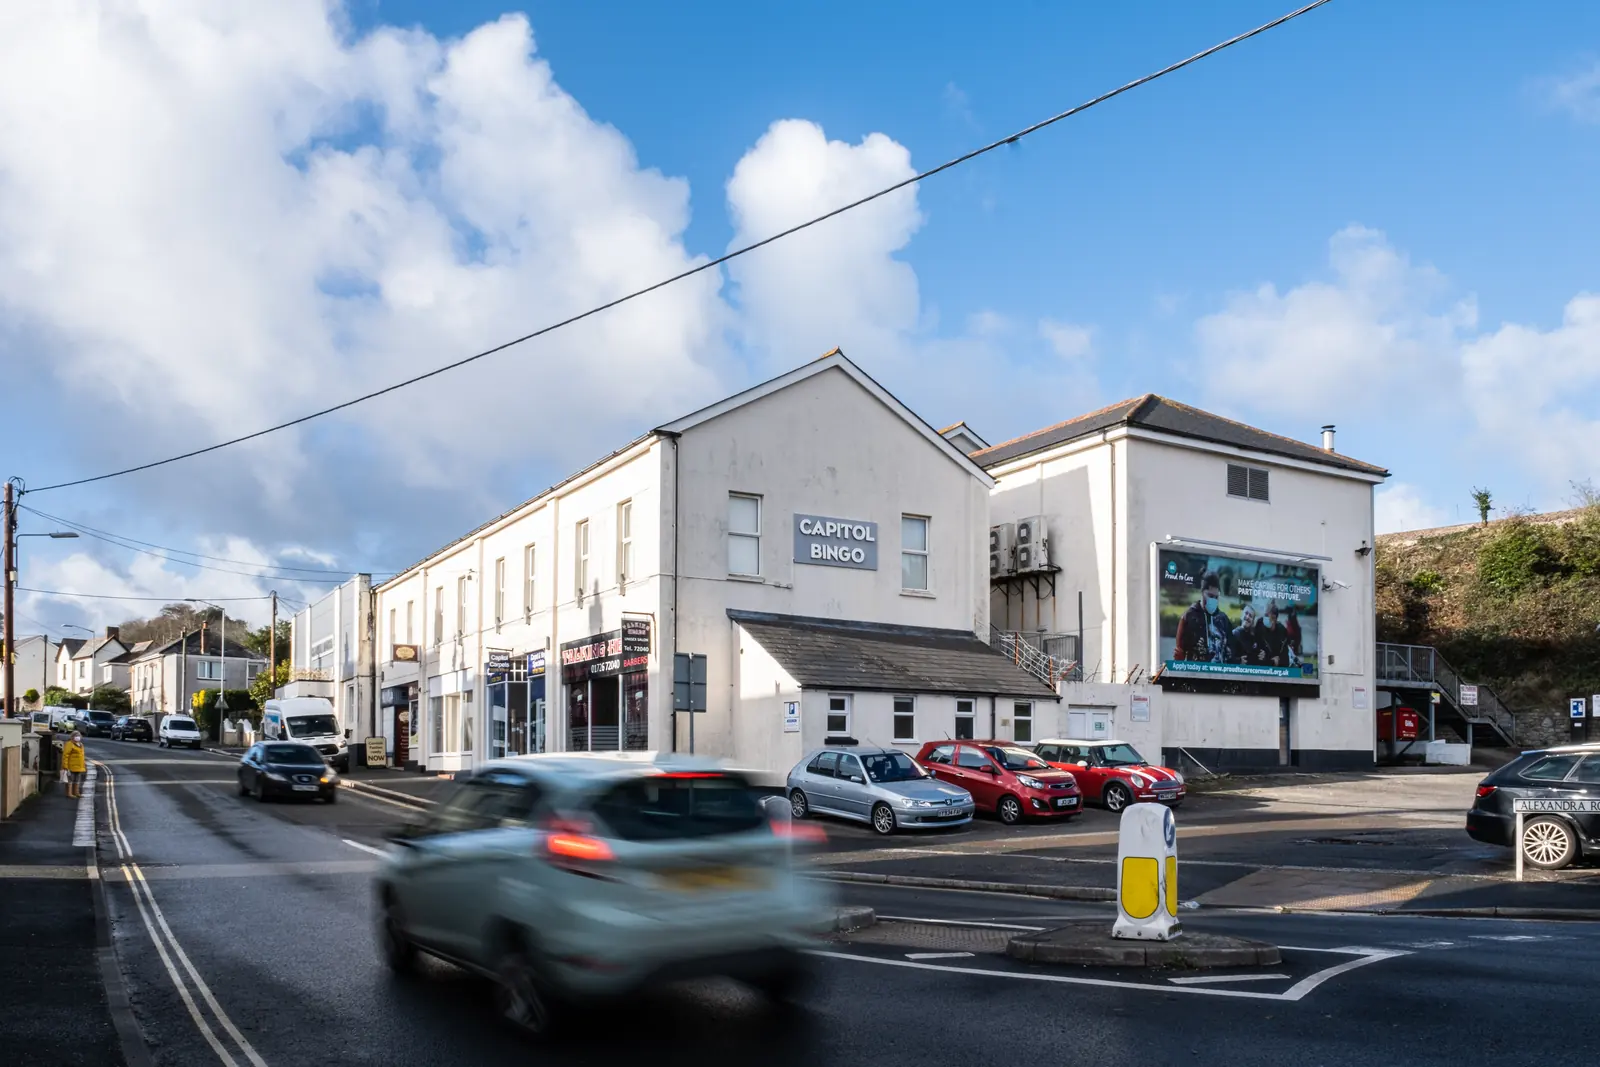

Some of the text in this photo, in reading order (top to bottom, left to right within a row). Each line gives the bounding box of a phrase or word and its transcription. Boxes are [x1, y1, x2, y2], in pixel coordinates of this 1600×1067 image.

[799, 518, 875, 542] CAPITOL
[810, 543, 865, 563] BINGO
[1164, 570, 1178, 580] Proud
[1183, 573, 1194, 582] Care
[1238, 580, 1311, 595] MAKE CARING FOR OTHERS
[1238, 587, 1301, 601] PART OF YOUR FUTURE.
[489, 661, 510, 669] Carpets
[490, 654, 509, 662] Capitol
[591, 656, 648, 674] 01726 72040 BARBERS
[1172, 662, 1187, 671] Apply
[1187, 664, 1201, 672] today
[1209, 666, 1289, 676] www.proudtocarecornwall.org.uk
[1520, 801, 1586, 811] ALEXANDRA
